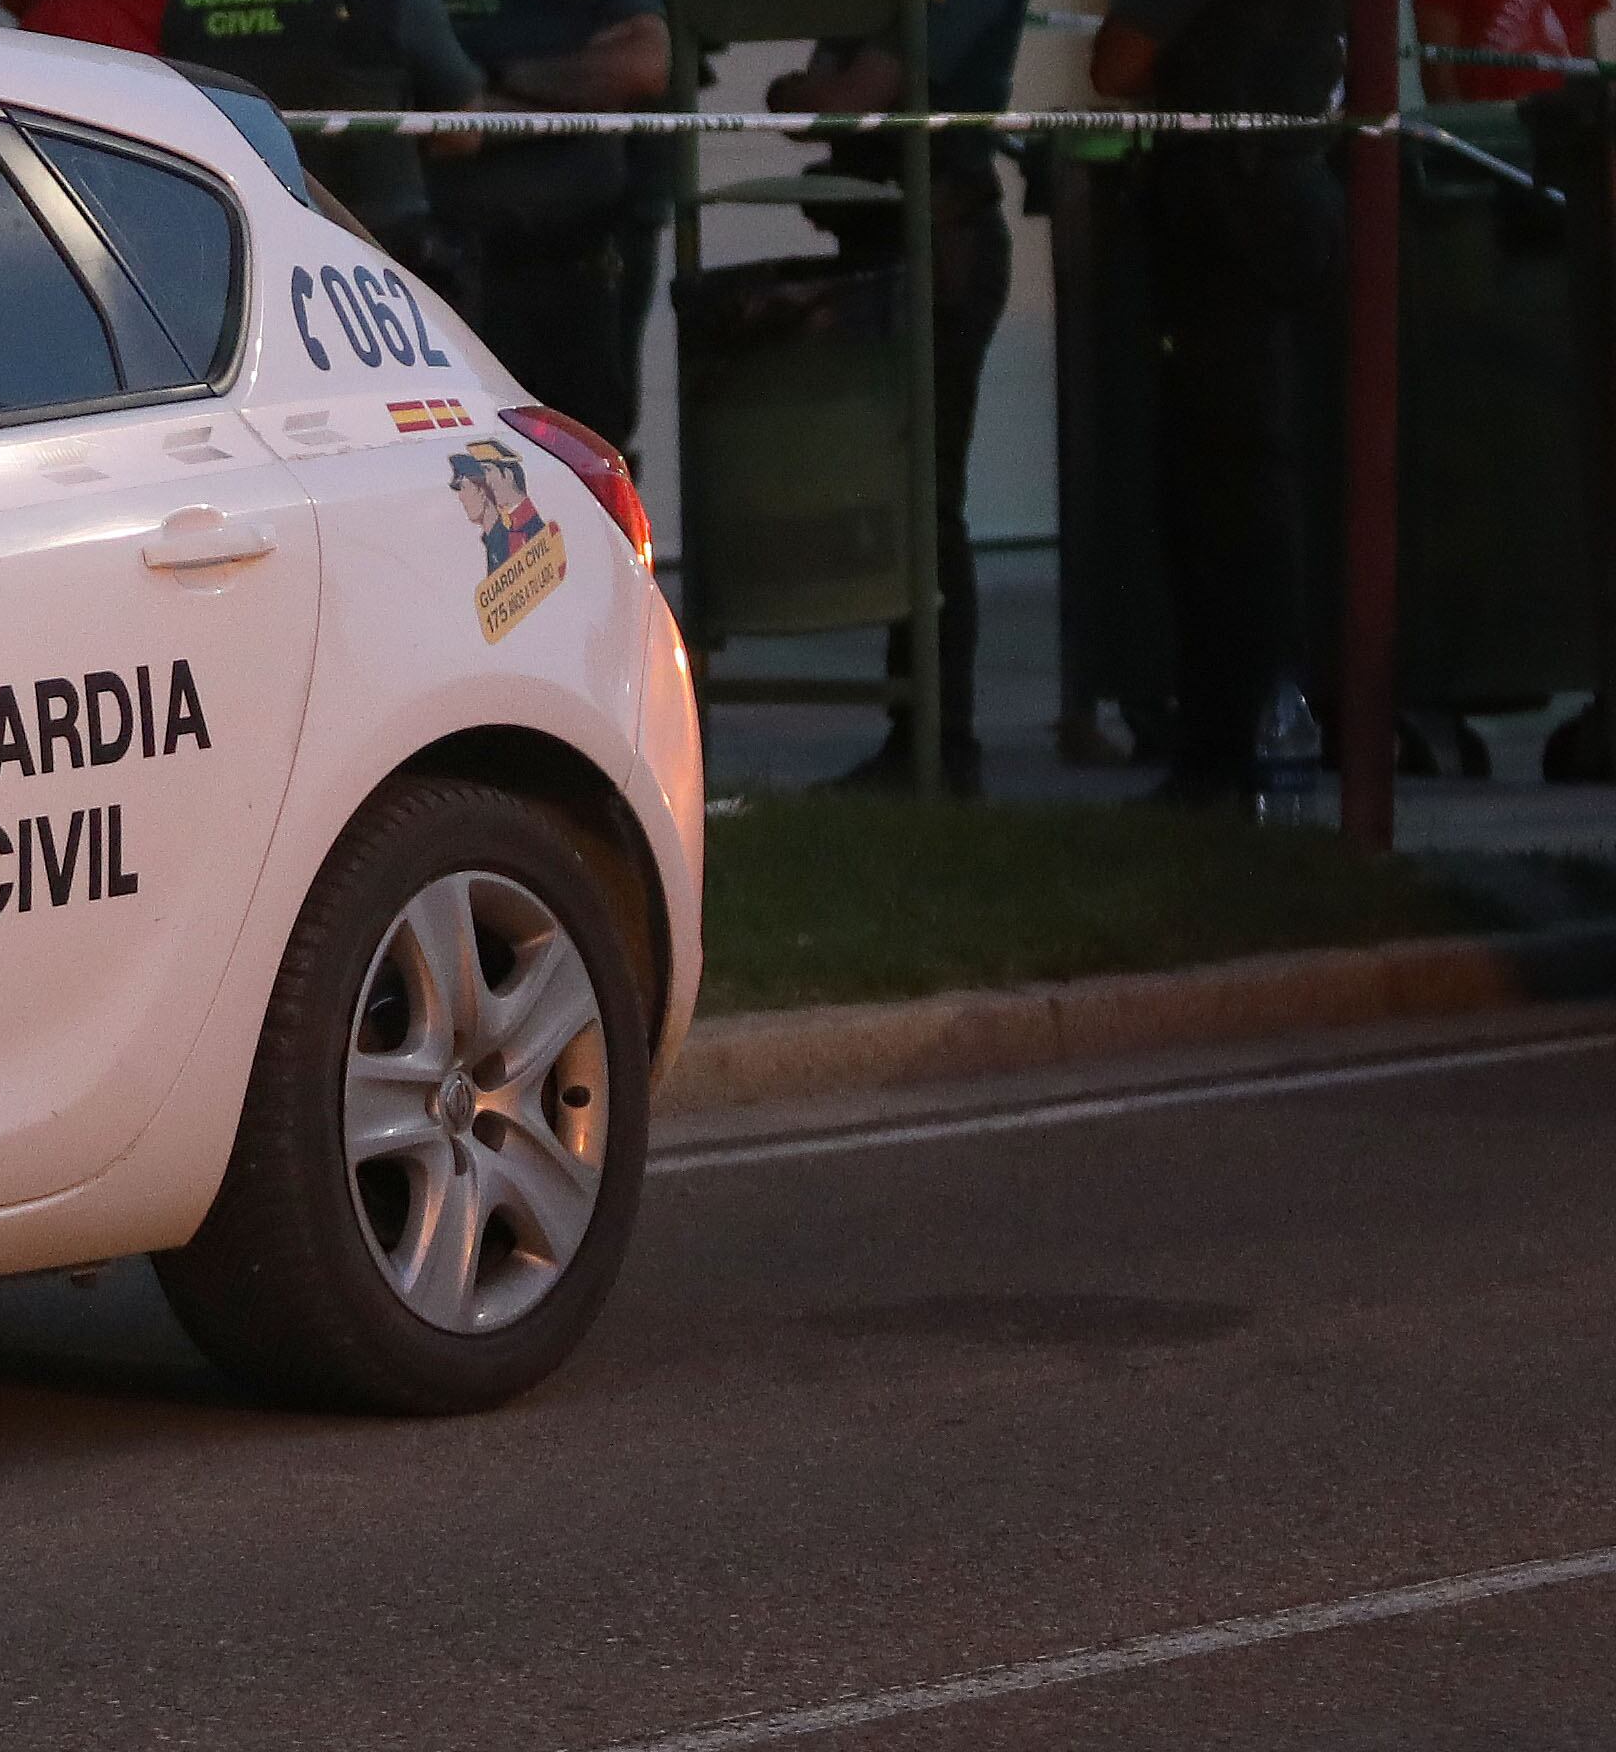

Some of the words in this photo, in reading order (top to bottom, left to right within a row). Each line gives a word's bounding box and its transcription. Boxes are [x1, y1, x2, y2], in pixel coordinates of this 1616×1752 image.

[205, 8, 285, 36] CIVIL
[320, 264, 452, 369] 062
[479, 560, 525, 608] GUARDIA
[525, 536, 550, 567] CIVIL
[486, 602, 508, 634] 175
